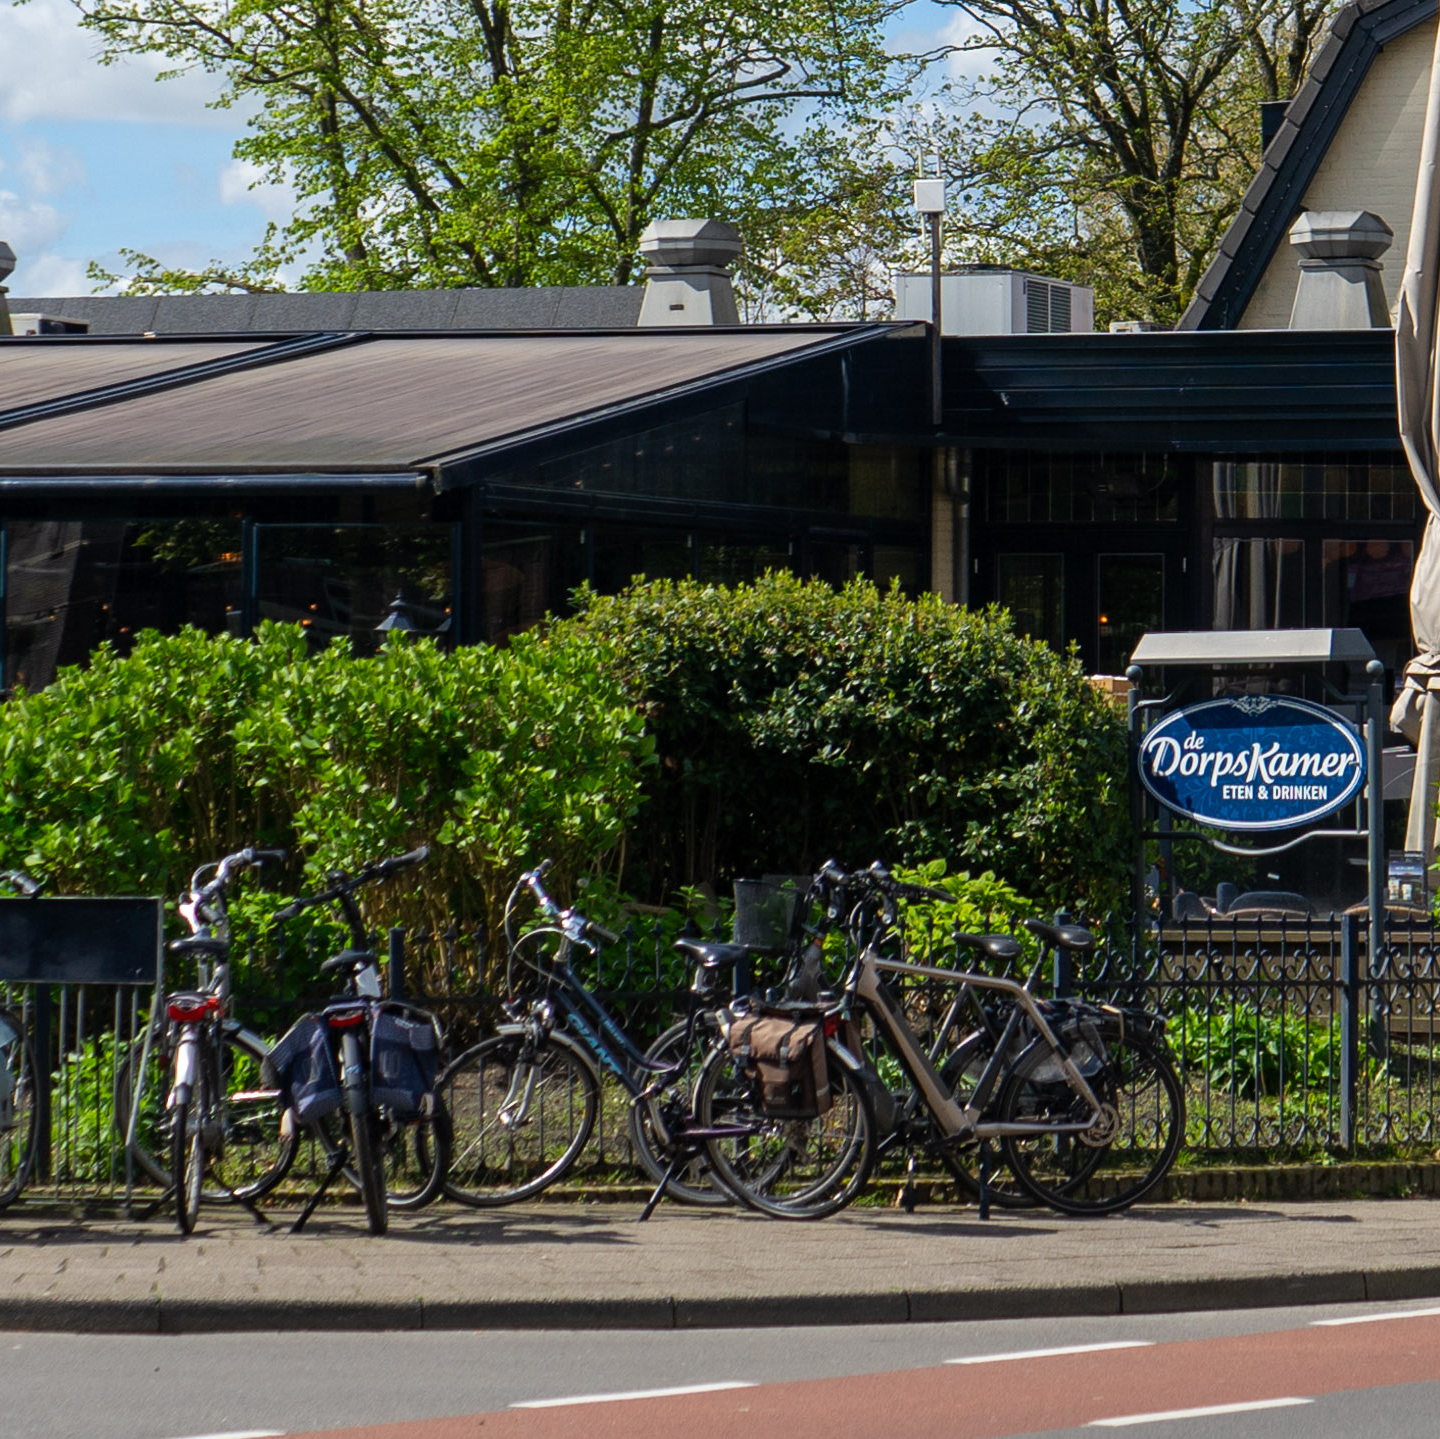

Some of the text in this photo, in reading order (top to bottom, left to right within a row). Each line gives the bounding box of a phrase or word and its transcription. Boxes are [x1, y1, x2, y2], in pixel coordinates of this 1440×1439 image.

[1183, 730, 1205, 750] de
[1148, 736, 1355, 787] DorpsKamer
[1222, 785, 1328, 800] ETEN & DRINKEN
[568, 1013, 623, 1075] GIANT
